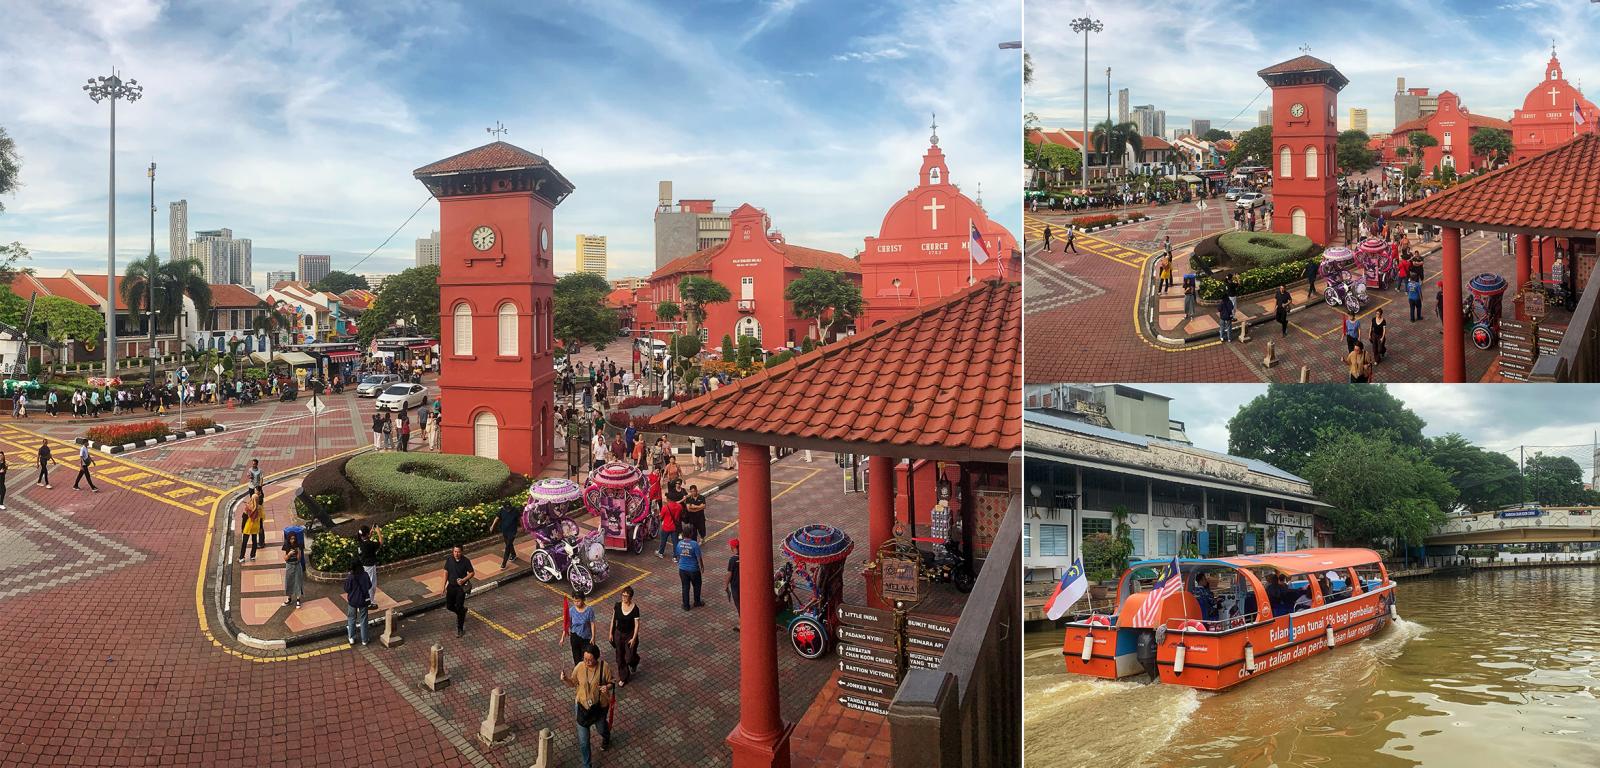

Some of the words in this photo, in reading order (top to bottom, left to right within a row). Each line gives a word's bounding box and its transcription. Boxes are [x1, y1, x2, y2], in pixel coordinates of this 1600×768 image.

[885, 583, 914, 592] MELAKA
[1307, 617, 1324, 631] tunai
[1336, 610, 1348, 624] bagi
[928, 624, 950, 632] MELAKA
[846, 632, 866, 640] PADANG
[1269, 652, 1291, 668] talian
[1293, 646, 1306, 658] dan
[846, 665, 868, 674] BASTION
[870, 670, 894, 678] VICTORIA
[846, 682, 866, 690] JONKER
